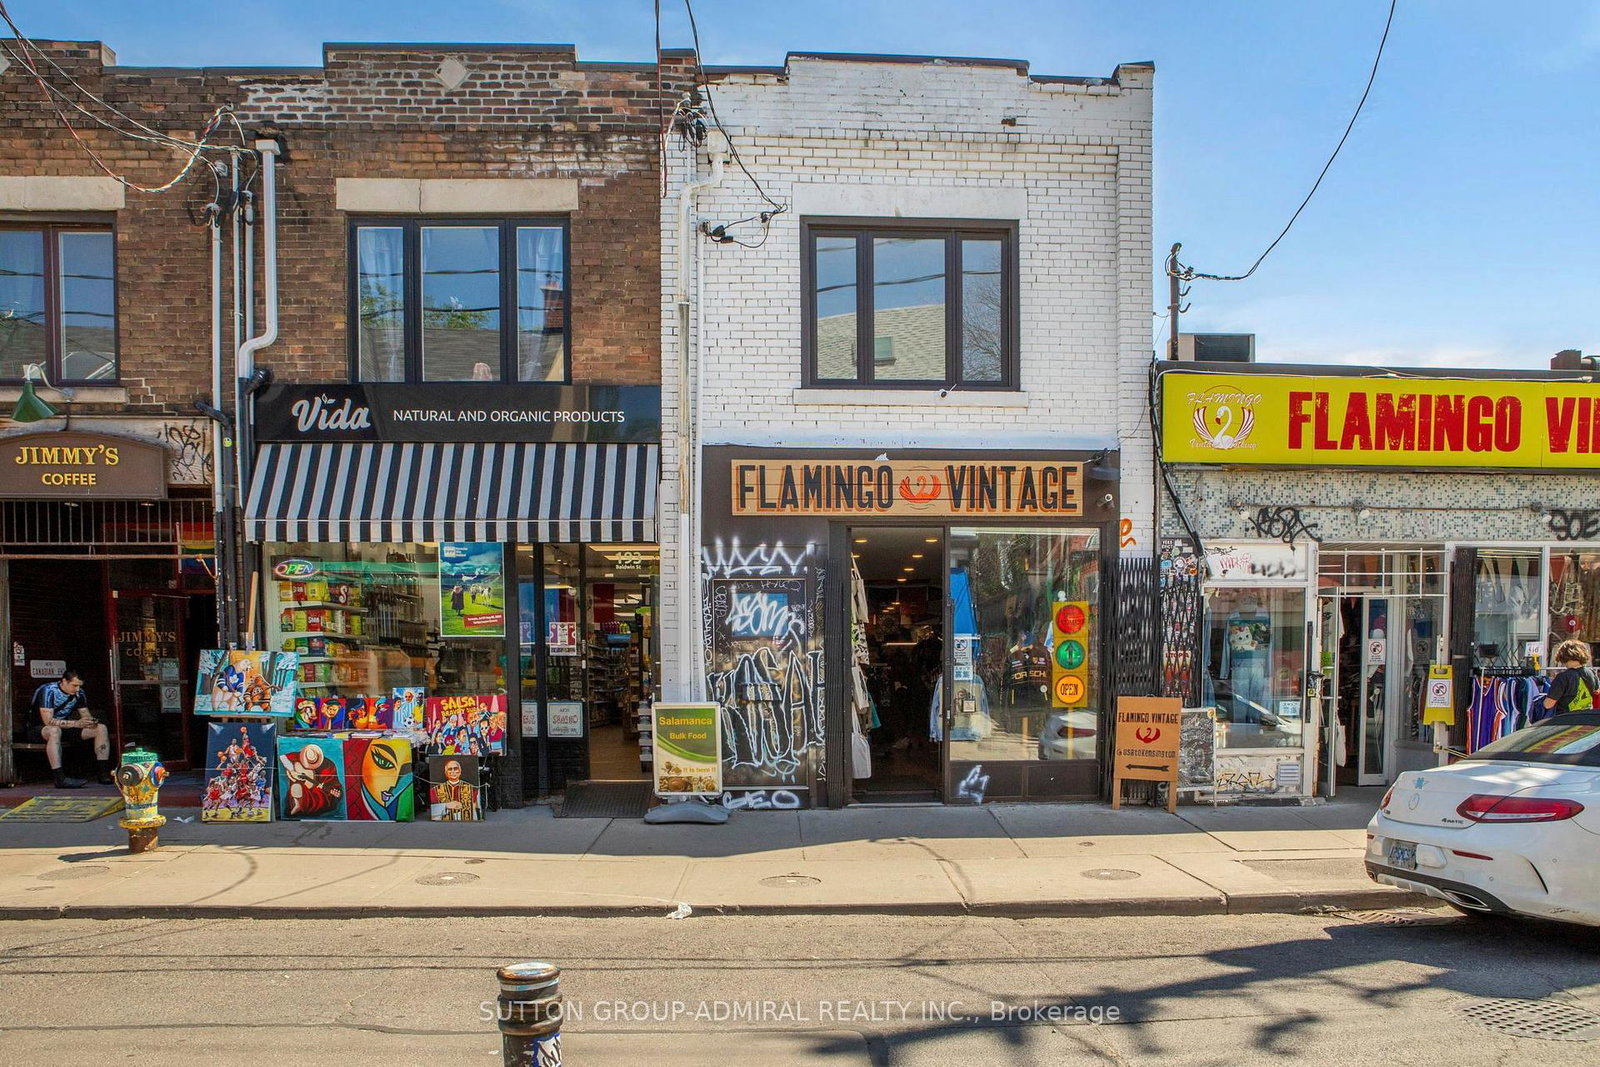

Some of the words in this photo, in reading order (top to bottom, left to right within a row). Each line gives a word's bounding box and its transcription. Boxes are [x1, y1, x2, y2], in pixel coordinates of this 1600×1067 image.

[1187, 392, 1263, 406] FLAMINGO
[291, 393, 371, 432] Vida
[393, 409, 455, 422] NATURAL
[458, 409, 487, 422] AND
[490, 409, 551, 423] ORGANIC
[554, 410, 625, 423] PRODUCTS
[1288, 391, 1521, 453] FLAMINGO
[1546, 396, 1600, 455] VI
[15, 444, 120, 466] JIMMY'S
[41, 473, 97, 486] COFFEE
[736, 464, 894, 512] FLAMINGO
[945, 464, 1078, 512] VINTAGE
[615, 551, 642, 565] 193
[275, 563, 313, 576] OPEN
[118, 631, 177, 643] JIMMY'S
[1060, 683, 1079, 696] OPEN
[440, 696, 475, 710] SALSA
[659, 716, 713, 726] Salamanca
[1117, 712, 1150, 723] FLAMINGO
[1151, 713, 1179, 724] VINTAGE
[669, 732, 686, 740] Bulk
[687, 732, 707, 740] Food
